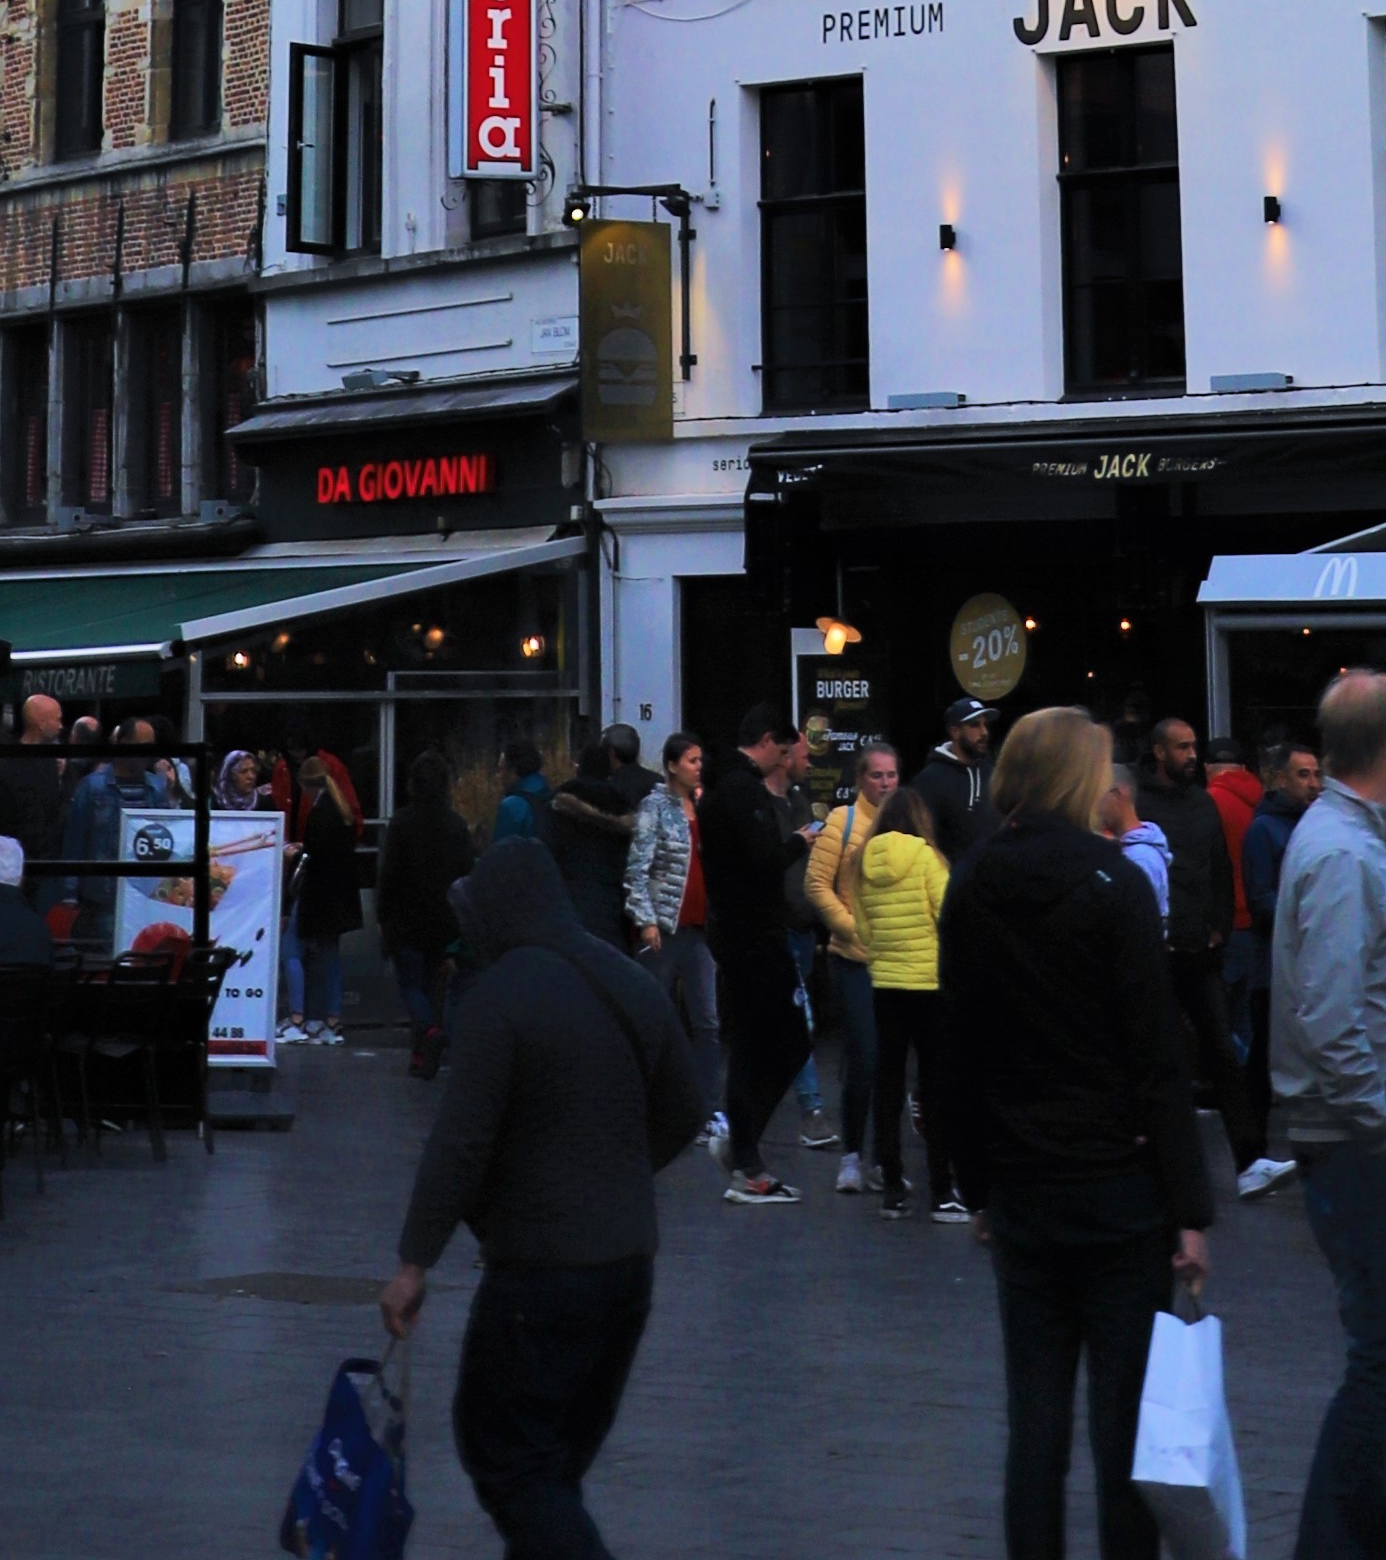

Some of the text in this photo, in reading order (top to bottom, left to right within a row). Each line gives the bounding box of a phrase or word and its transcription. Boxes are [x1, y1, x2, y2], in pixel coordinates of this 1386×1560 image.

[821, 2, 945, 45] PREMIUM
[604, 241, 647, 265] JACK
[1093, 453, 1152, 479] JACK
[316, 454, 489, 503] DA GIOVANNI
[23, 664, 117, 696] RISTORANTE
[816, 680, 870, 698] BURGER
[640, 703, 652, 721] 16
[136, 837, 171, 856] 6.50
[225, 987, 264, 999] TO GO
